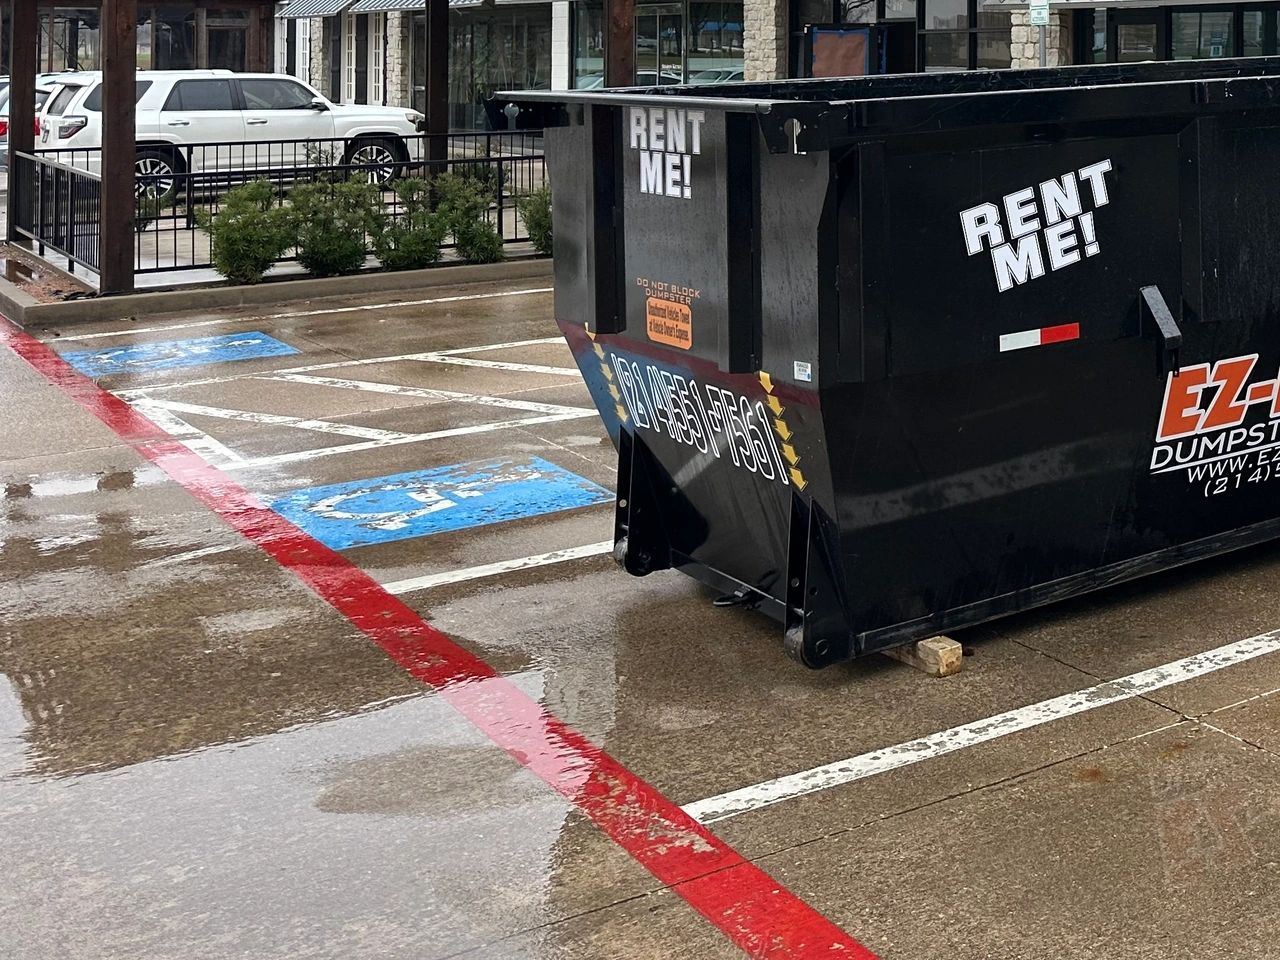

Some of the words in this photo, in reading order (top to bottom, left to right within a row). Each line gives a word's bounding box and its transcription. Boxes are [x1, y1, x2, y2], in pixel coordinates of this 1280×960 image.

[629, 106, 705, 155] RENT
[640, 150, 692, 200] ME!
[959, 158, 1113, 257] RENT
[990, 211, 1101, 293] ME!
[636, 277, 649, 287] DO
[651, 280, 669, 291] NOT
[671, 284, 701, 299] BLOCK
[645, 288, 692, 305] DUMPSTER
[610, 352, 790, 486] (214)551-7561
